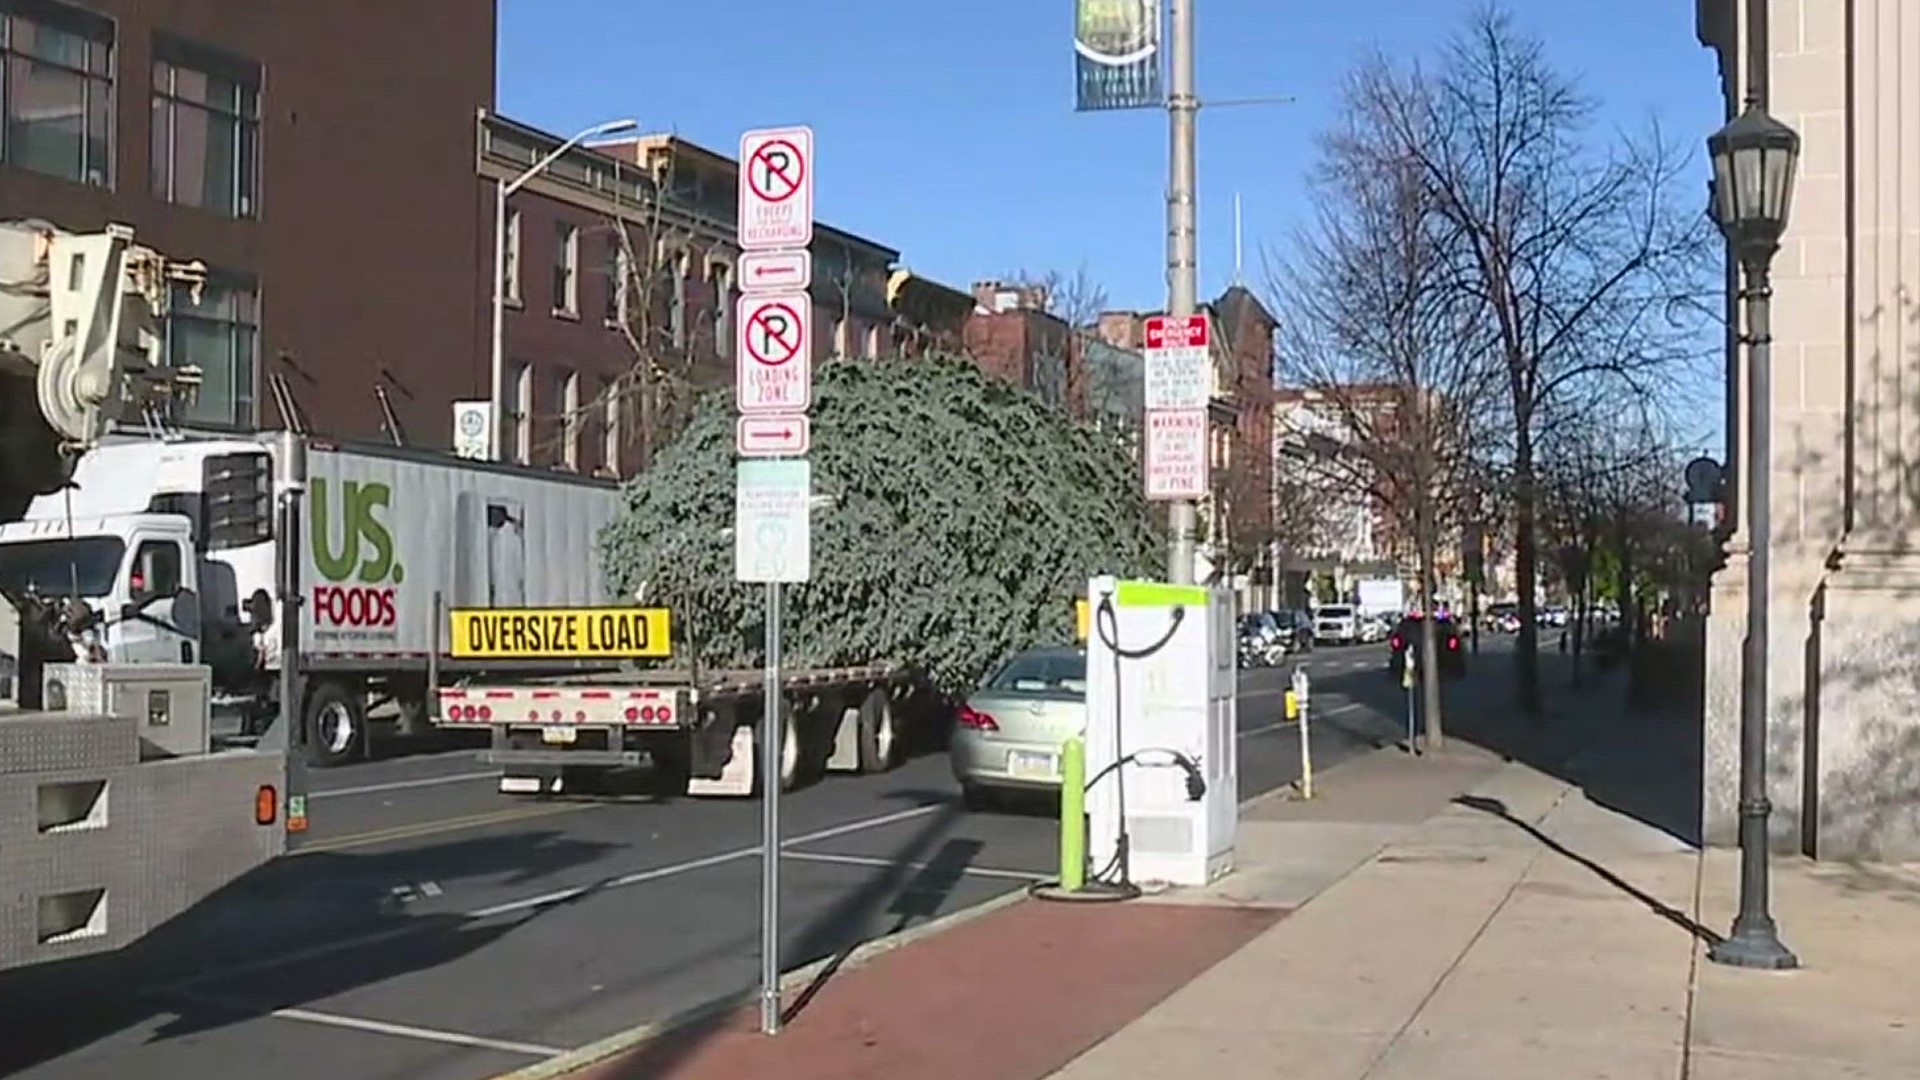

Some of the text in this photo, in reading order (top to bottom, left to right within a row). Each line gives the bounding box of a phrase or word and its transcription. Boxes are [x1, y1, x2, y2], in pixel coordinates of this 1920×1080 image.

[749, 367, 798, 386] LOADING
[758, 385, 788, 402] ZONE
[1153, 415, 1201, 428] WARNING
[313, 587, 397, 626] FOODS
[469, 614, 648, 651] OVERSIZE LOAD
